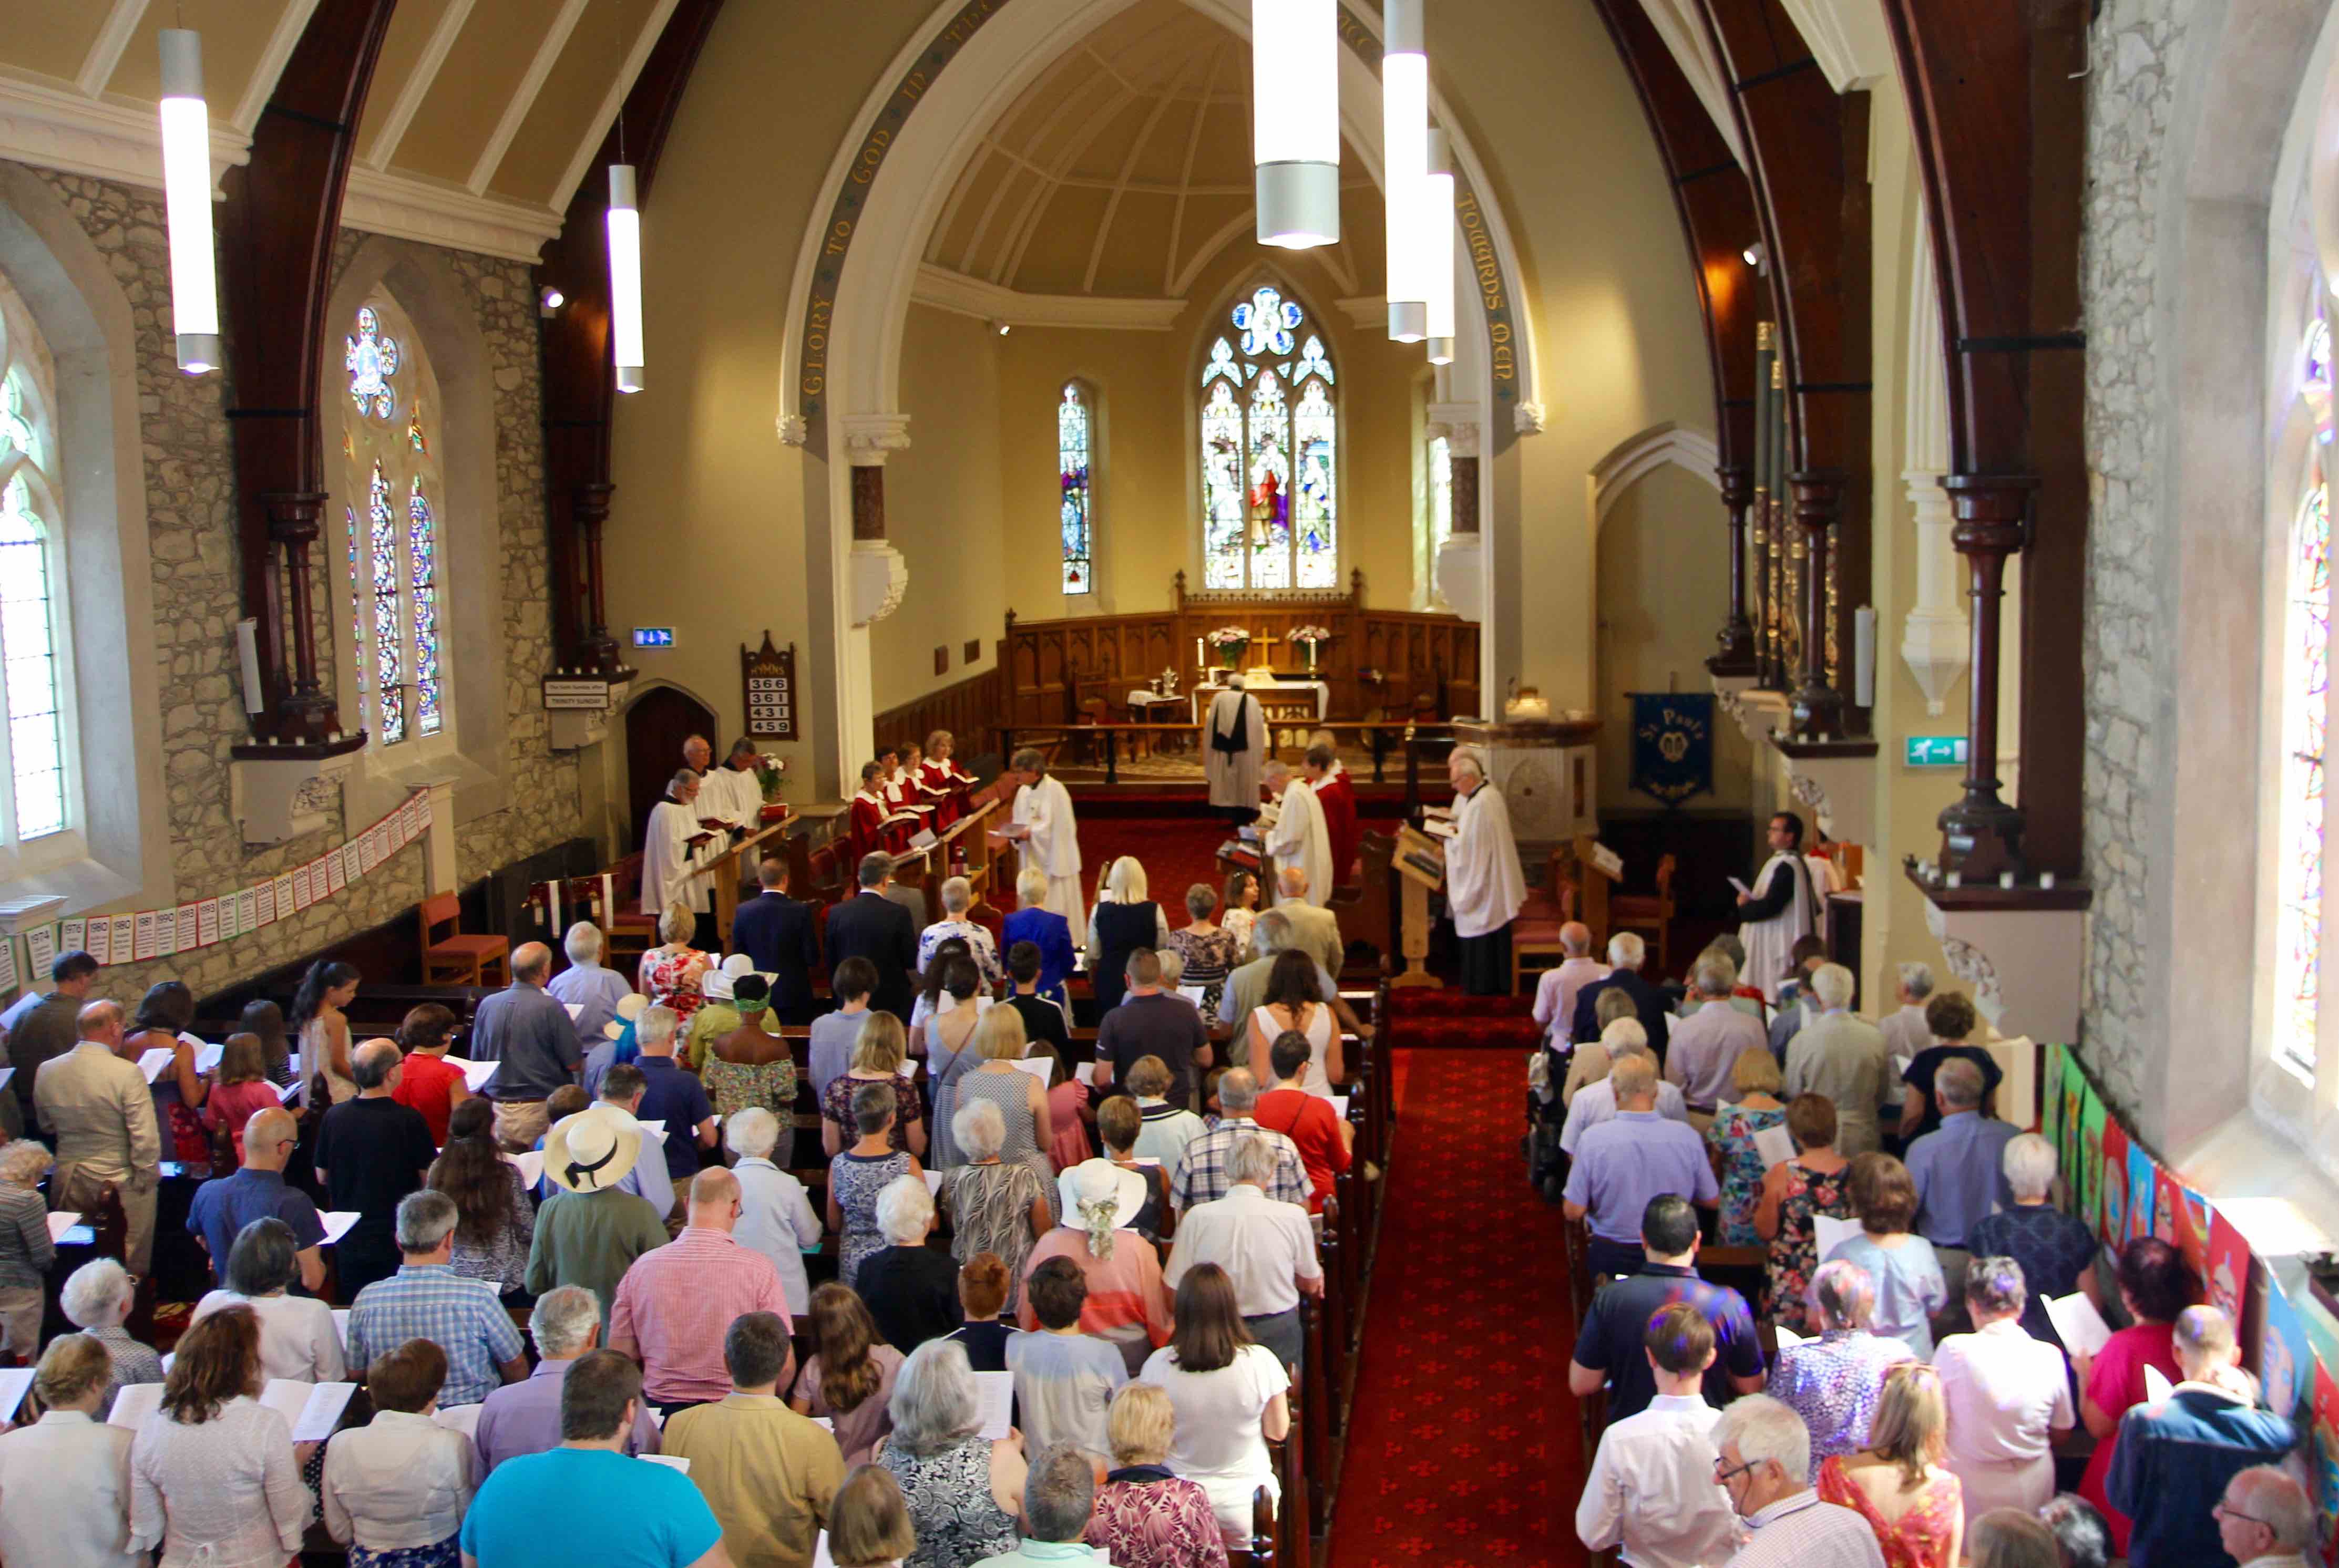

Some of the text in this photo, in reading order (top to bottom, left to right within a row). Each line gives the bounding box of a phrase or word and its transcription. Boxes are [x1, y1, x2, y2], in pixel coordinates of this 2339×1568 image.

[853, 130, 889, 184] GOD
[750, 664, 785, 675] HYMNS
[752, 679, 785, 689] 366
[752, 694, 783, 703] 361
[753, 707, 784, 717] 431
[754, 721, 788, 731] 459
